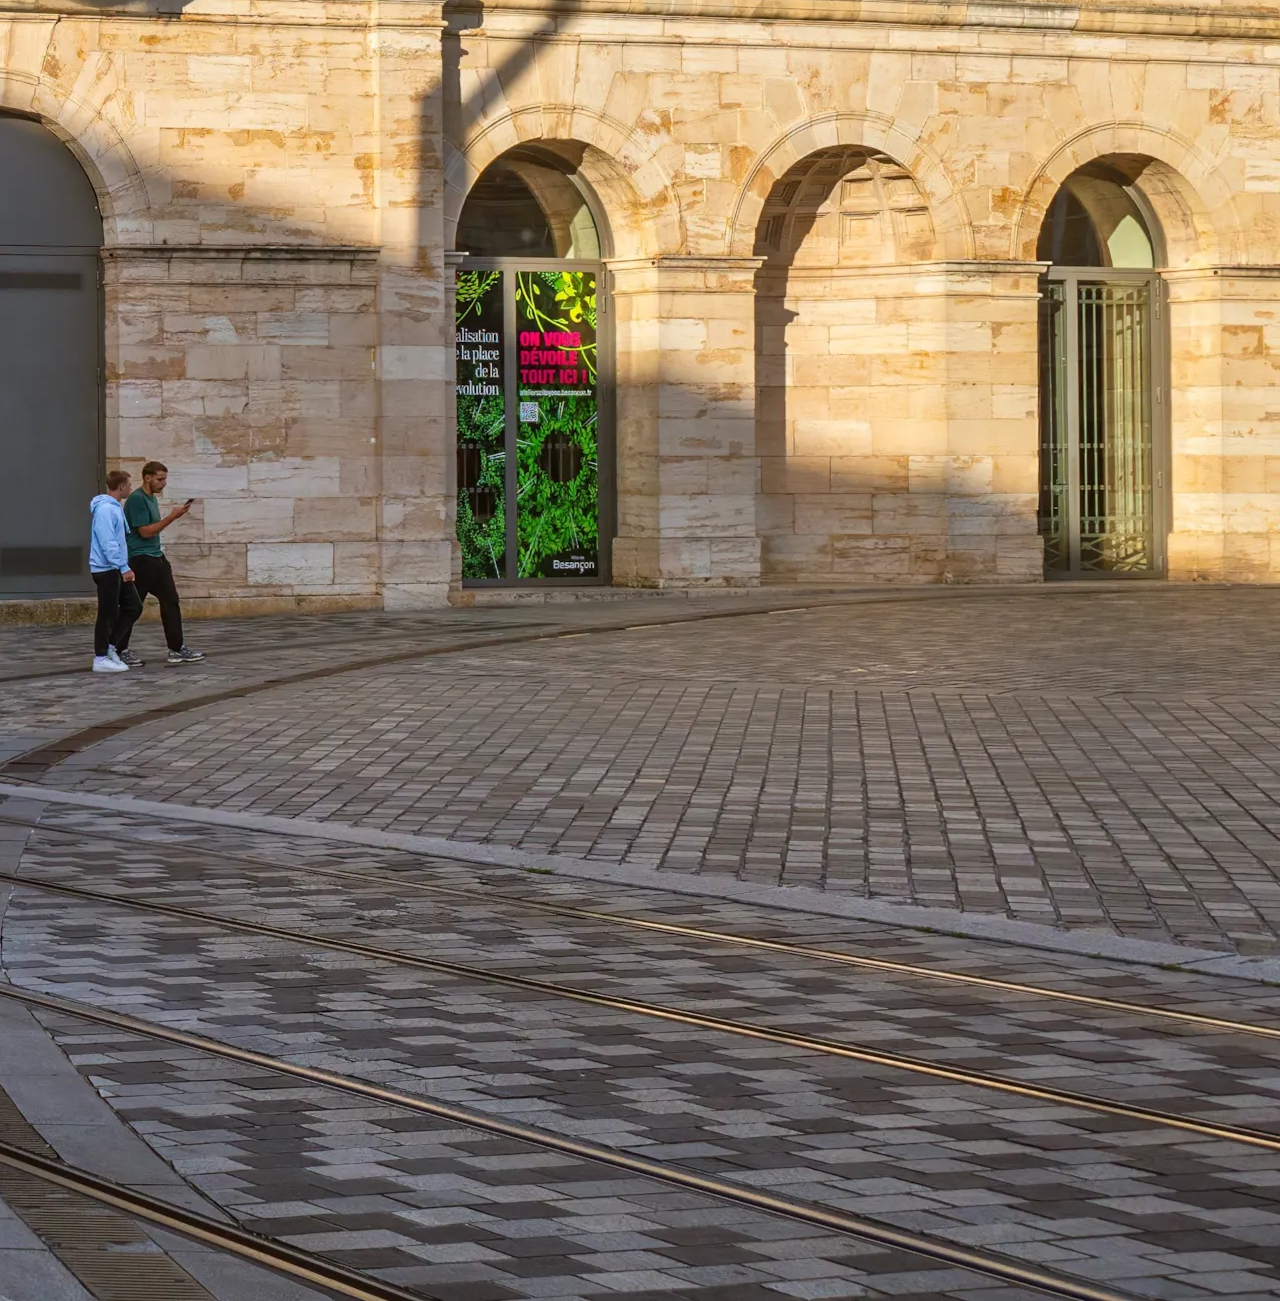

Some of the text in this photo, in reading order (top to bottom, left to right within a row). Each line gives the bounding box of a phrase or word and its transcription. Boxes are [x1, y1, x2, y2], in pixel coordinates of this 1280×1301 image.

[456, 327, 499, 343] alisation
[520, 331, 580, 347] ON VOUS
[461, 345, 470, 360] la
[472, 345, 499, 364] place
[520, 347, 578, 365] DÉVOILE
[475, 363, 499, 378] de la
[520, 369, 556, 384] TOUT
[559, 369, 578, 384] ICI
[456, 380, 499, 396] volution
[553, 560, 595, 574] Besançon
